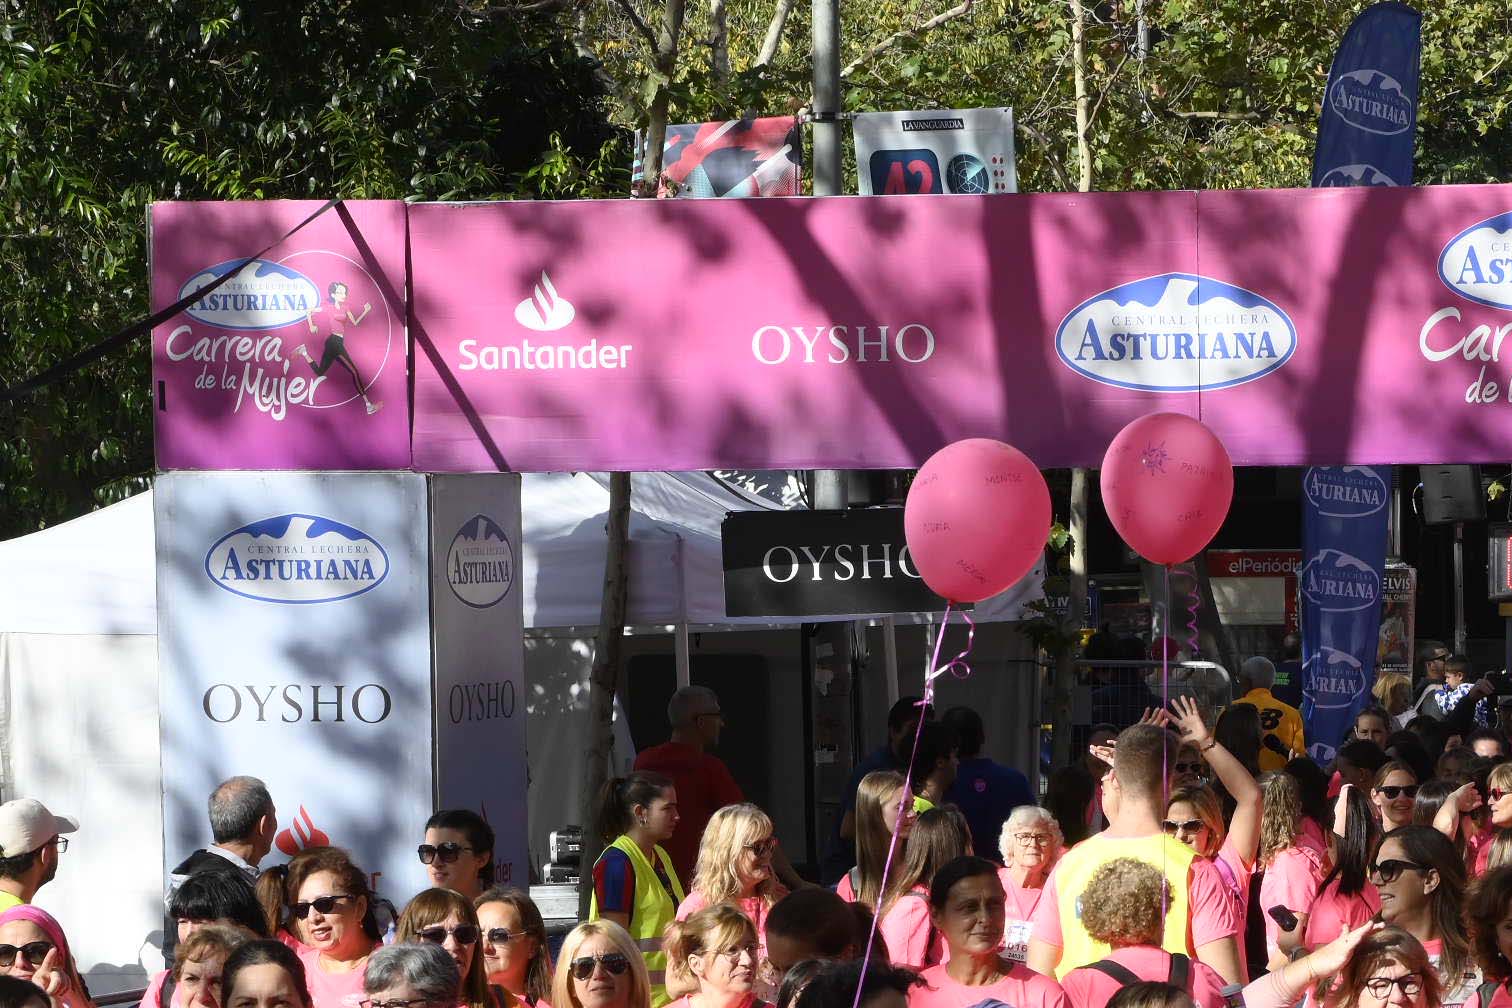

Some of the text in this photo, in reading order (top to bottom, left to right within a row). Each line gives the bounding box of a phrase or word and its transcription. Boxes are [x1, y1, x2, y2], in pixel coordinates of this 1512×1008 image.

[189, 284, 308, 311] ASTURIANA
[1112, 313, 1187, 326] CENTRAL
[165, 324, 283, 363] Carrera
[458, 338, 633, 371] Santander
[752, 324, 935, 365] OYSHO
[1075, 319, 1277, 362] ASTURIANA
[195, 359, 328, 421] de la Mujer
[1464, 366, 1500, 404] de
[219, 547, 376, 582] ASTURIANA
[248, 544, 369, 554] CENTRAL LECHERA
[452, 550, 510, 586] ASTURIANA
[202, 683, 393, 725] OYSHO
[449, 679, 516, 725] OYSHO
